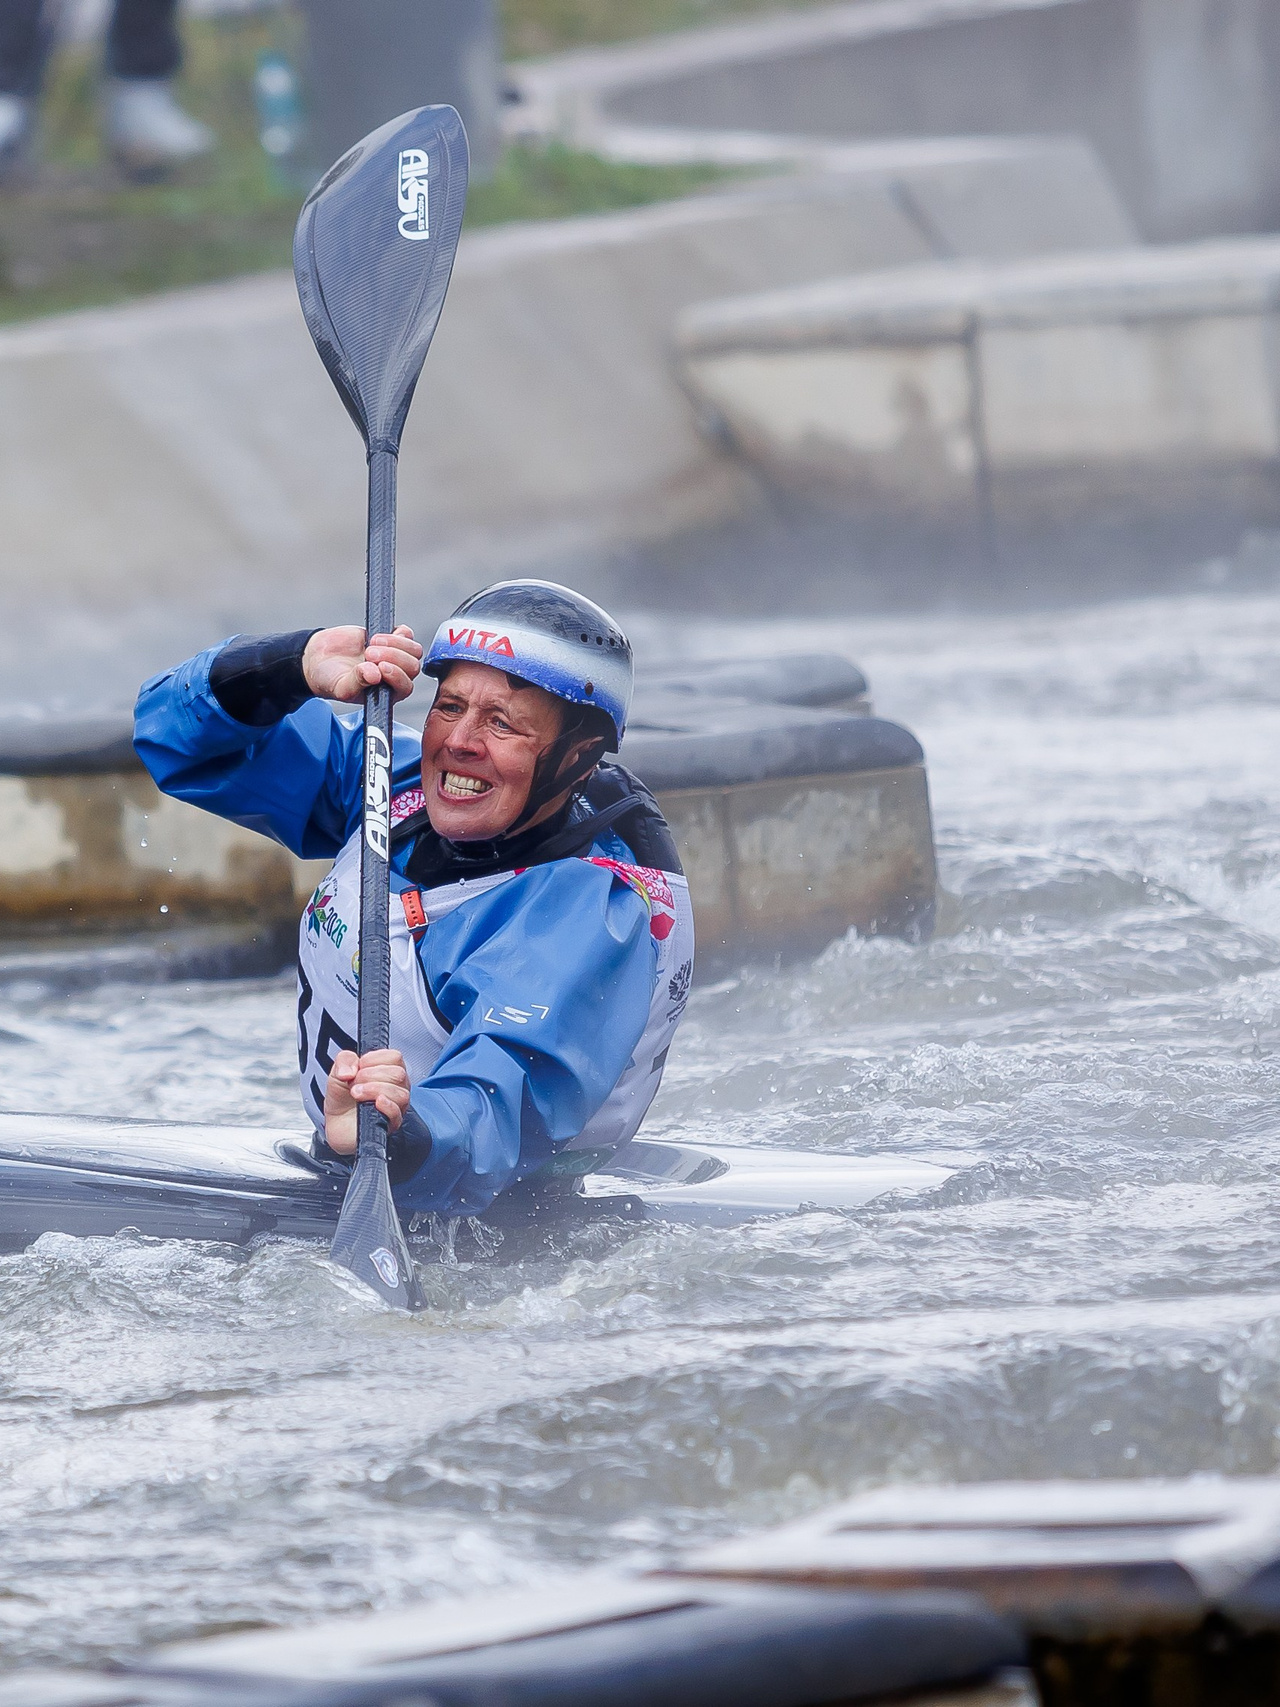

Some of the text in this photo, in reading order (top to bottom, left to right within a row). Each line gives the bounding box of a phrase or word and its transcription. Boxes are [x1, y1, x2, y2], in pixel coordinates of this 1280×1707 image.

[398, 149, 429, 240] AKSU
[449, 628, 515, 658] VITA
[366, 725, 391, 862] AKSU
[322, 906, 348, 949] 2026
